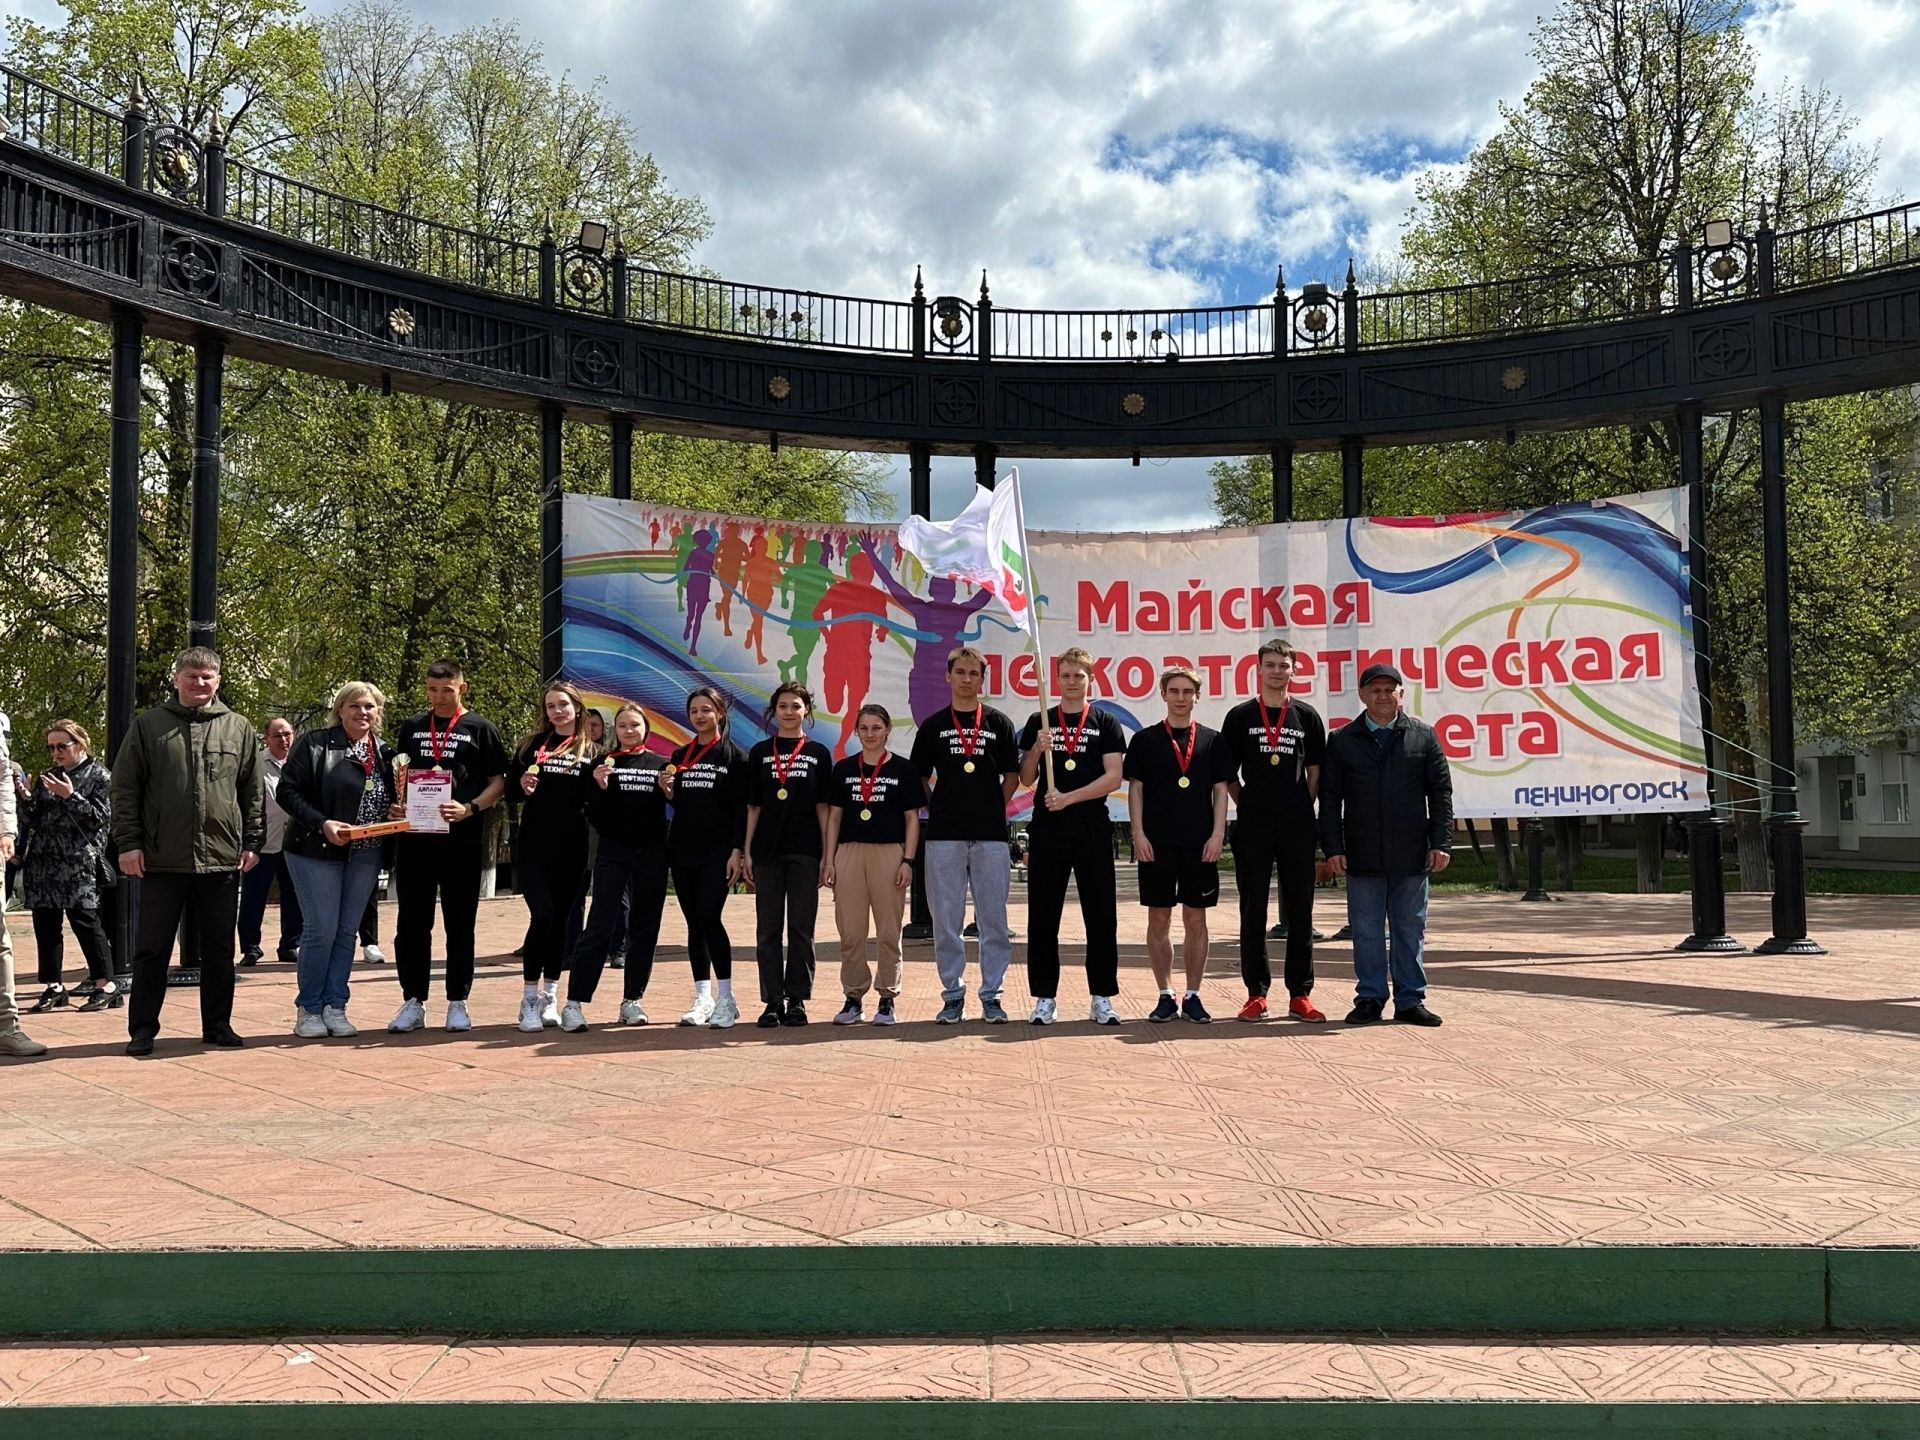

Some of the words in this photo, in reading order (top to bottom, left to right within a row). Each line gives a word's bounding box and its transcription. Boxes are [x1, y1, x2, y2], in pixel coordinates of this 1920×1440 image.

[1077, 578, 1371, 633] Майская
[976, 632, 1662, 698] лекотлетческая
[618, 775, 655, 784] НЕФТЯНОЙ
[682, 771, 717, 780] НЕФТЯНОЙ
[619, 784, 655, 792] ТЕХНИКУМ
[1514, 780, 1689, 807] ЛЕНИНОГОРСК
